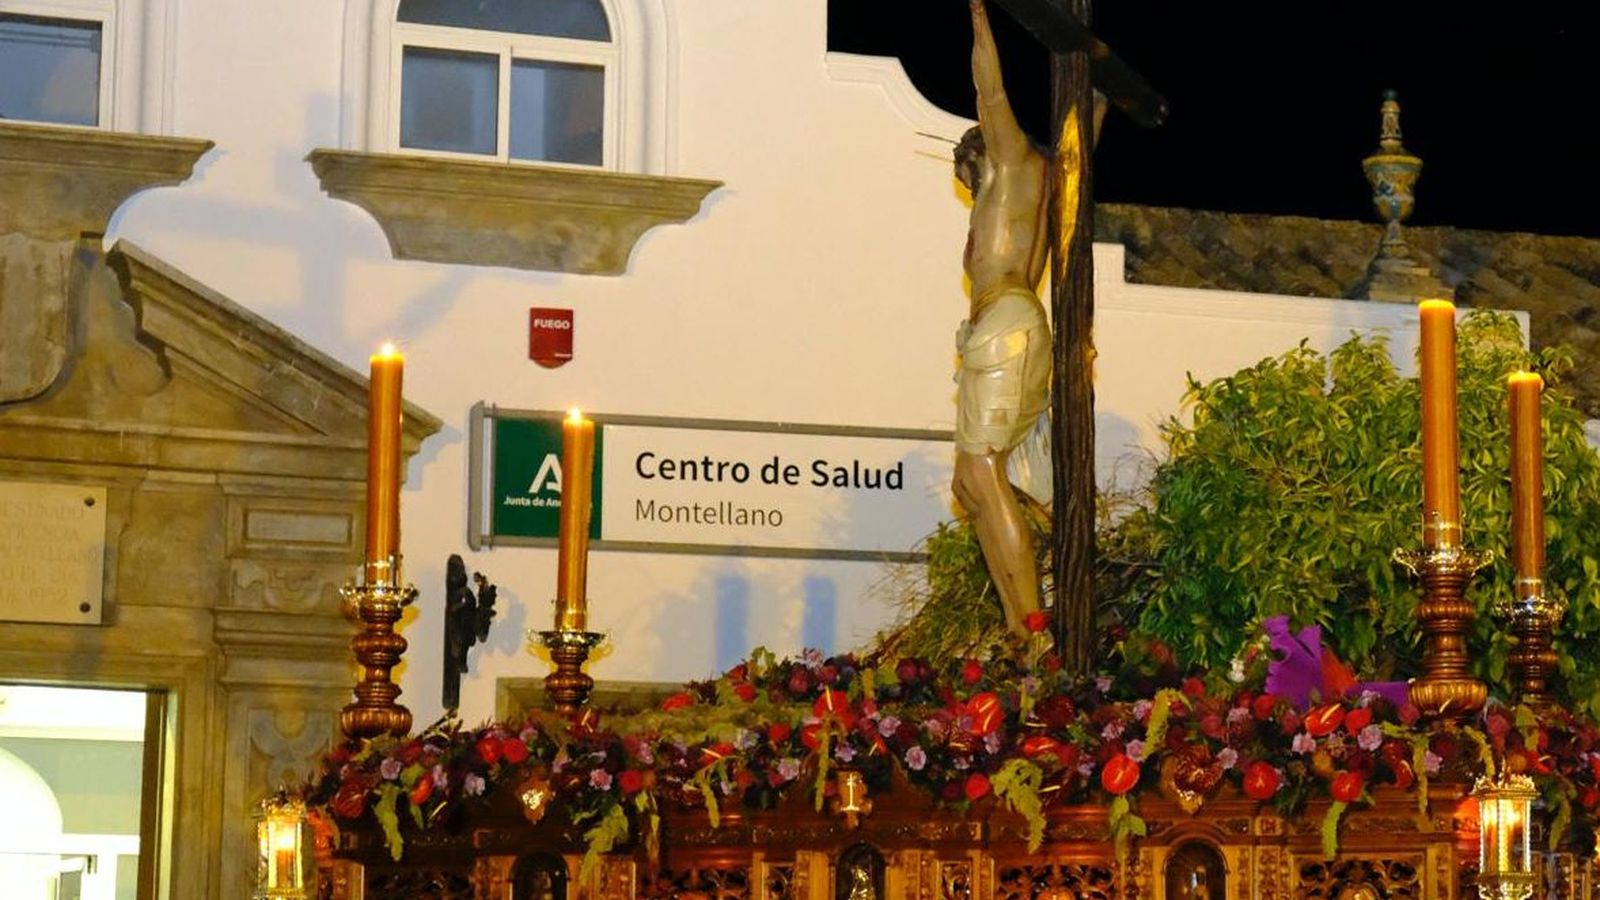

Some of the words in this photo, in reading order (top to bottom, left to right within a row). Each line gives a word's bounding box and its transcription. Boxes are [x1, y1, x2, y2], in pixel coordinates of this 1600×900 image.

[534, 318, 571, 330] FUEGO
[635, 451, 750, 483] Centro
[760, 456, 800, 487] de
[811, 458, 905, 491] Salud
[503, 496, 531, 506] Junta
[532, 497, 545, 507] de
[635, 499, 784, 527] Montellano
